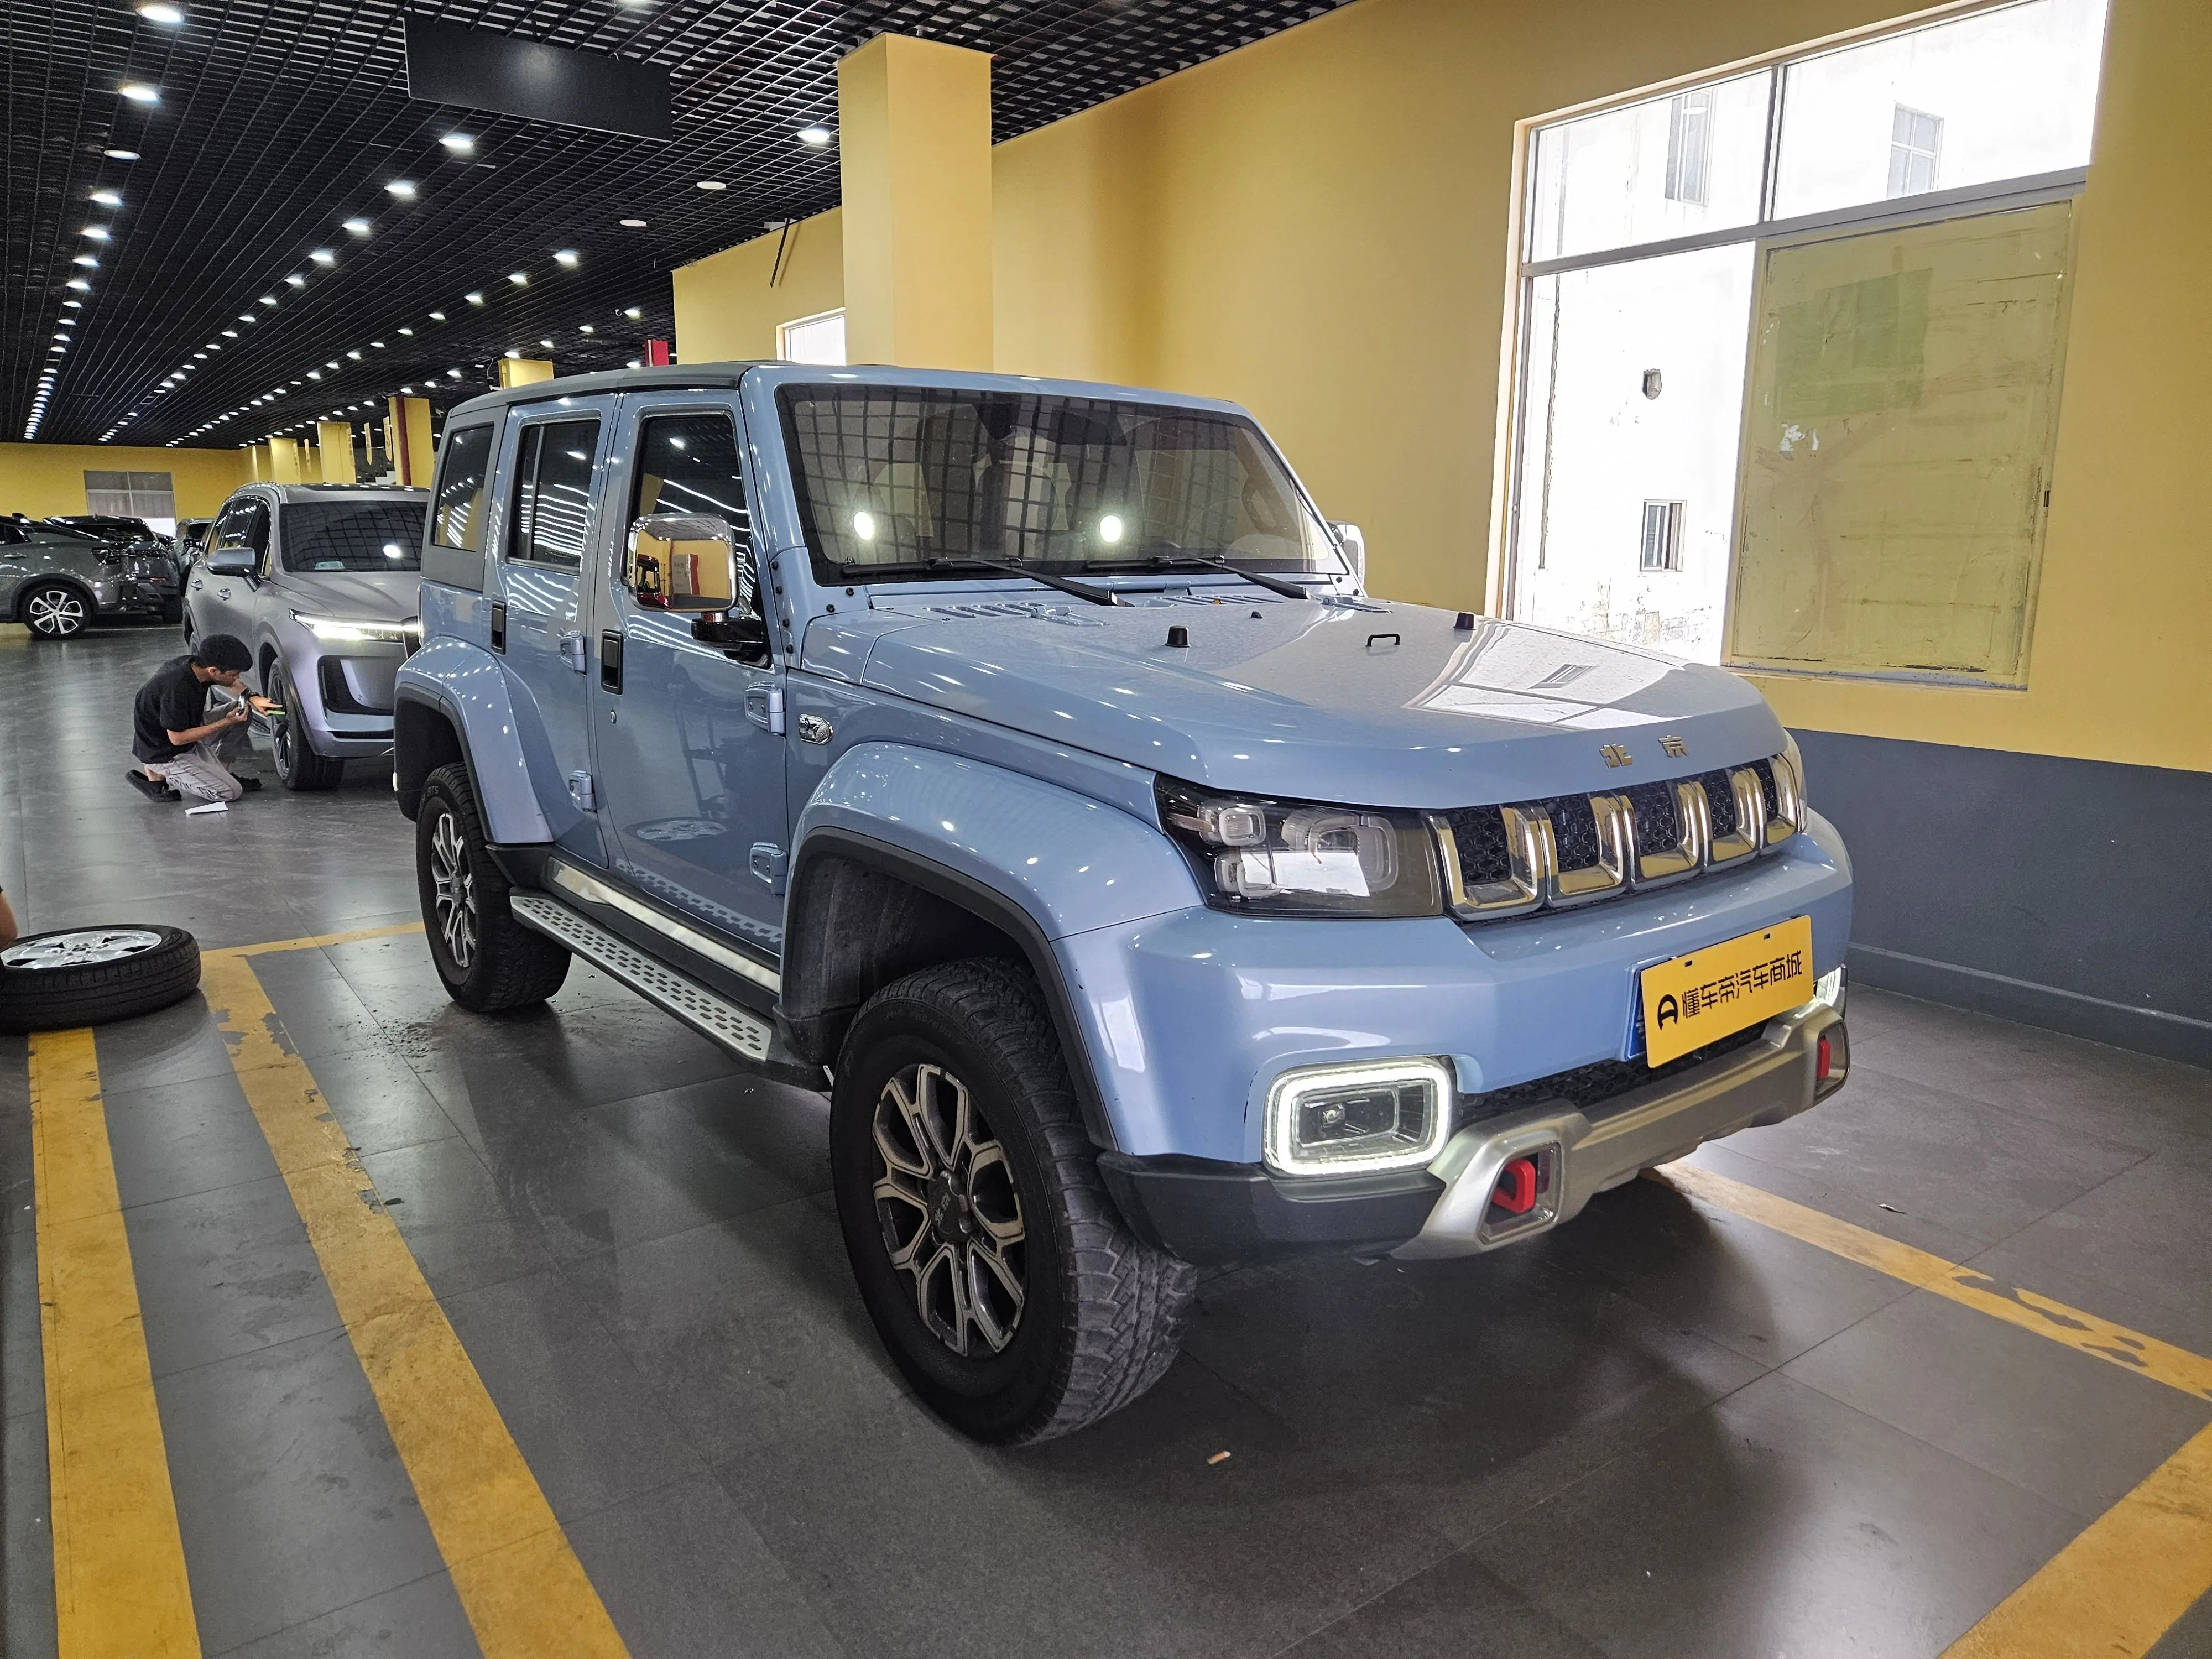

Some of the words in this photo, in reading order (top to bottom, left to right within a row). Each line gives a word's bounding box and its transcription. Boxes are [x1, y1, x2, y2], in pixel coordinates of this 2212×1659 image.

[1599, 735, 1689, 769] 北京
[1681, 950, 1803, 1019] 懂车帝汽车商城
